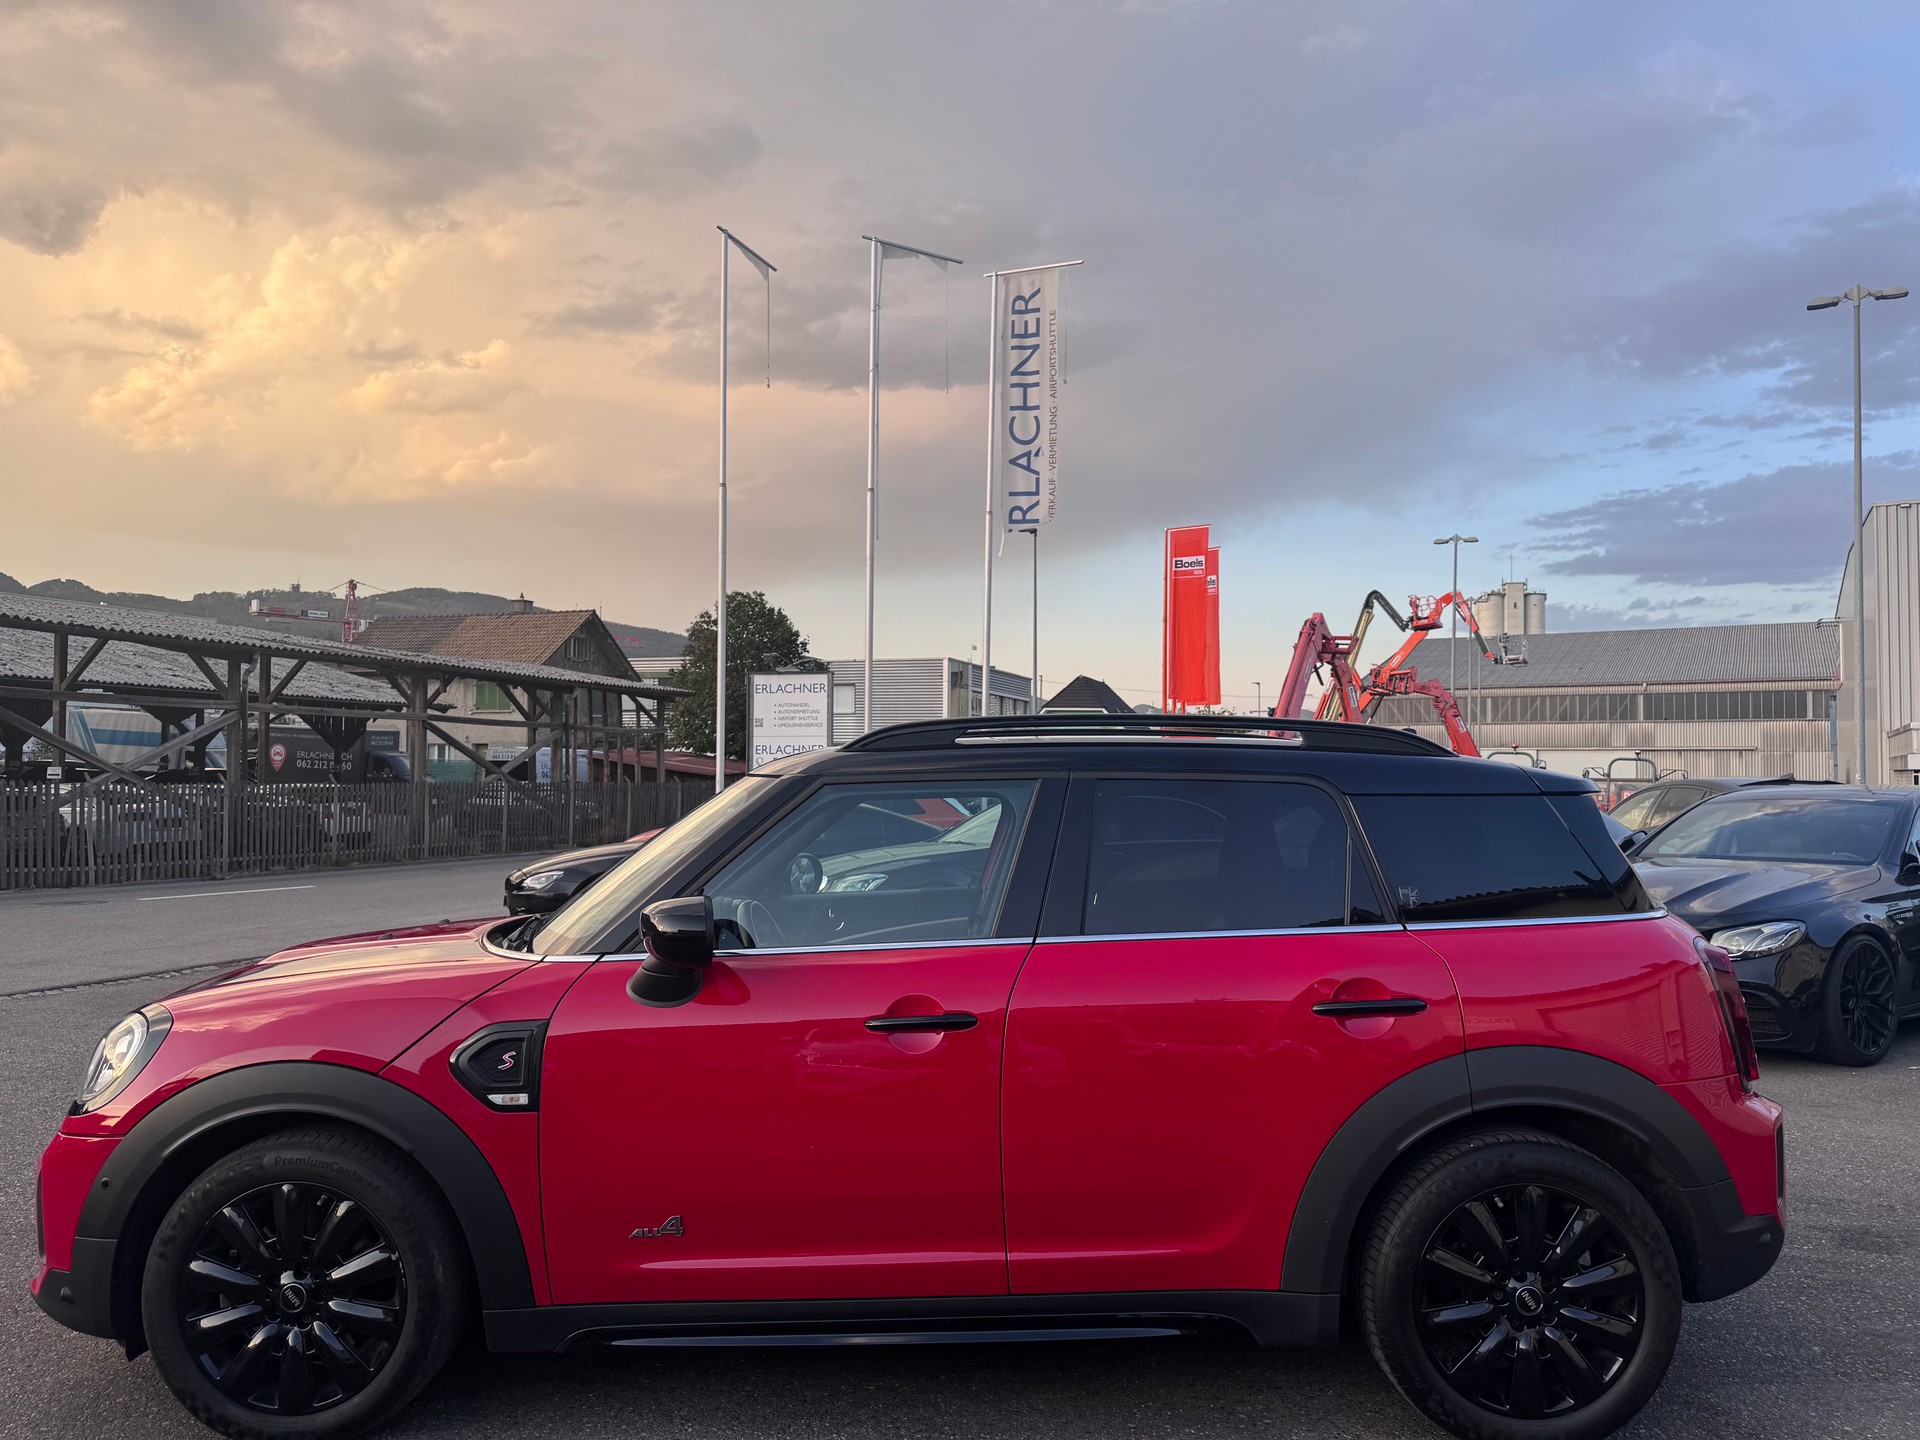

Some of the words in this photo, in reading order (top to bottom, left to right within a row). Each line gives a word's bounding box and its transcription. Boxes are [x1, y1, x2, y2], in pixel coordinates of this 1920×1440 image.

[1049, 309, 1057, 399] AIRPORTSHUTTLE
[1008, 286, 1042, 533] RLACHNER
[1048, 405, 1058, 472] VERMIETUNG
[1174, 558, 1203, 569] Boels
[755, 683, 827, 694] ERLACHNER
[296, 759, 312, 768] 062
[313, 760, 328, 769] 212
[497, 1050, 517, 1070] S
[274, 1155, 374, 1188] PremiumContact
[628, 1215, 684, 1238] ALL4
[284, 1288, 301, 1307] MINI
[1520, 1290, 1537, 1310] MINI
